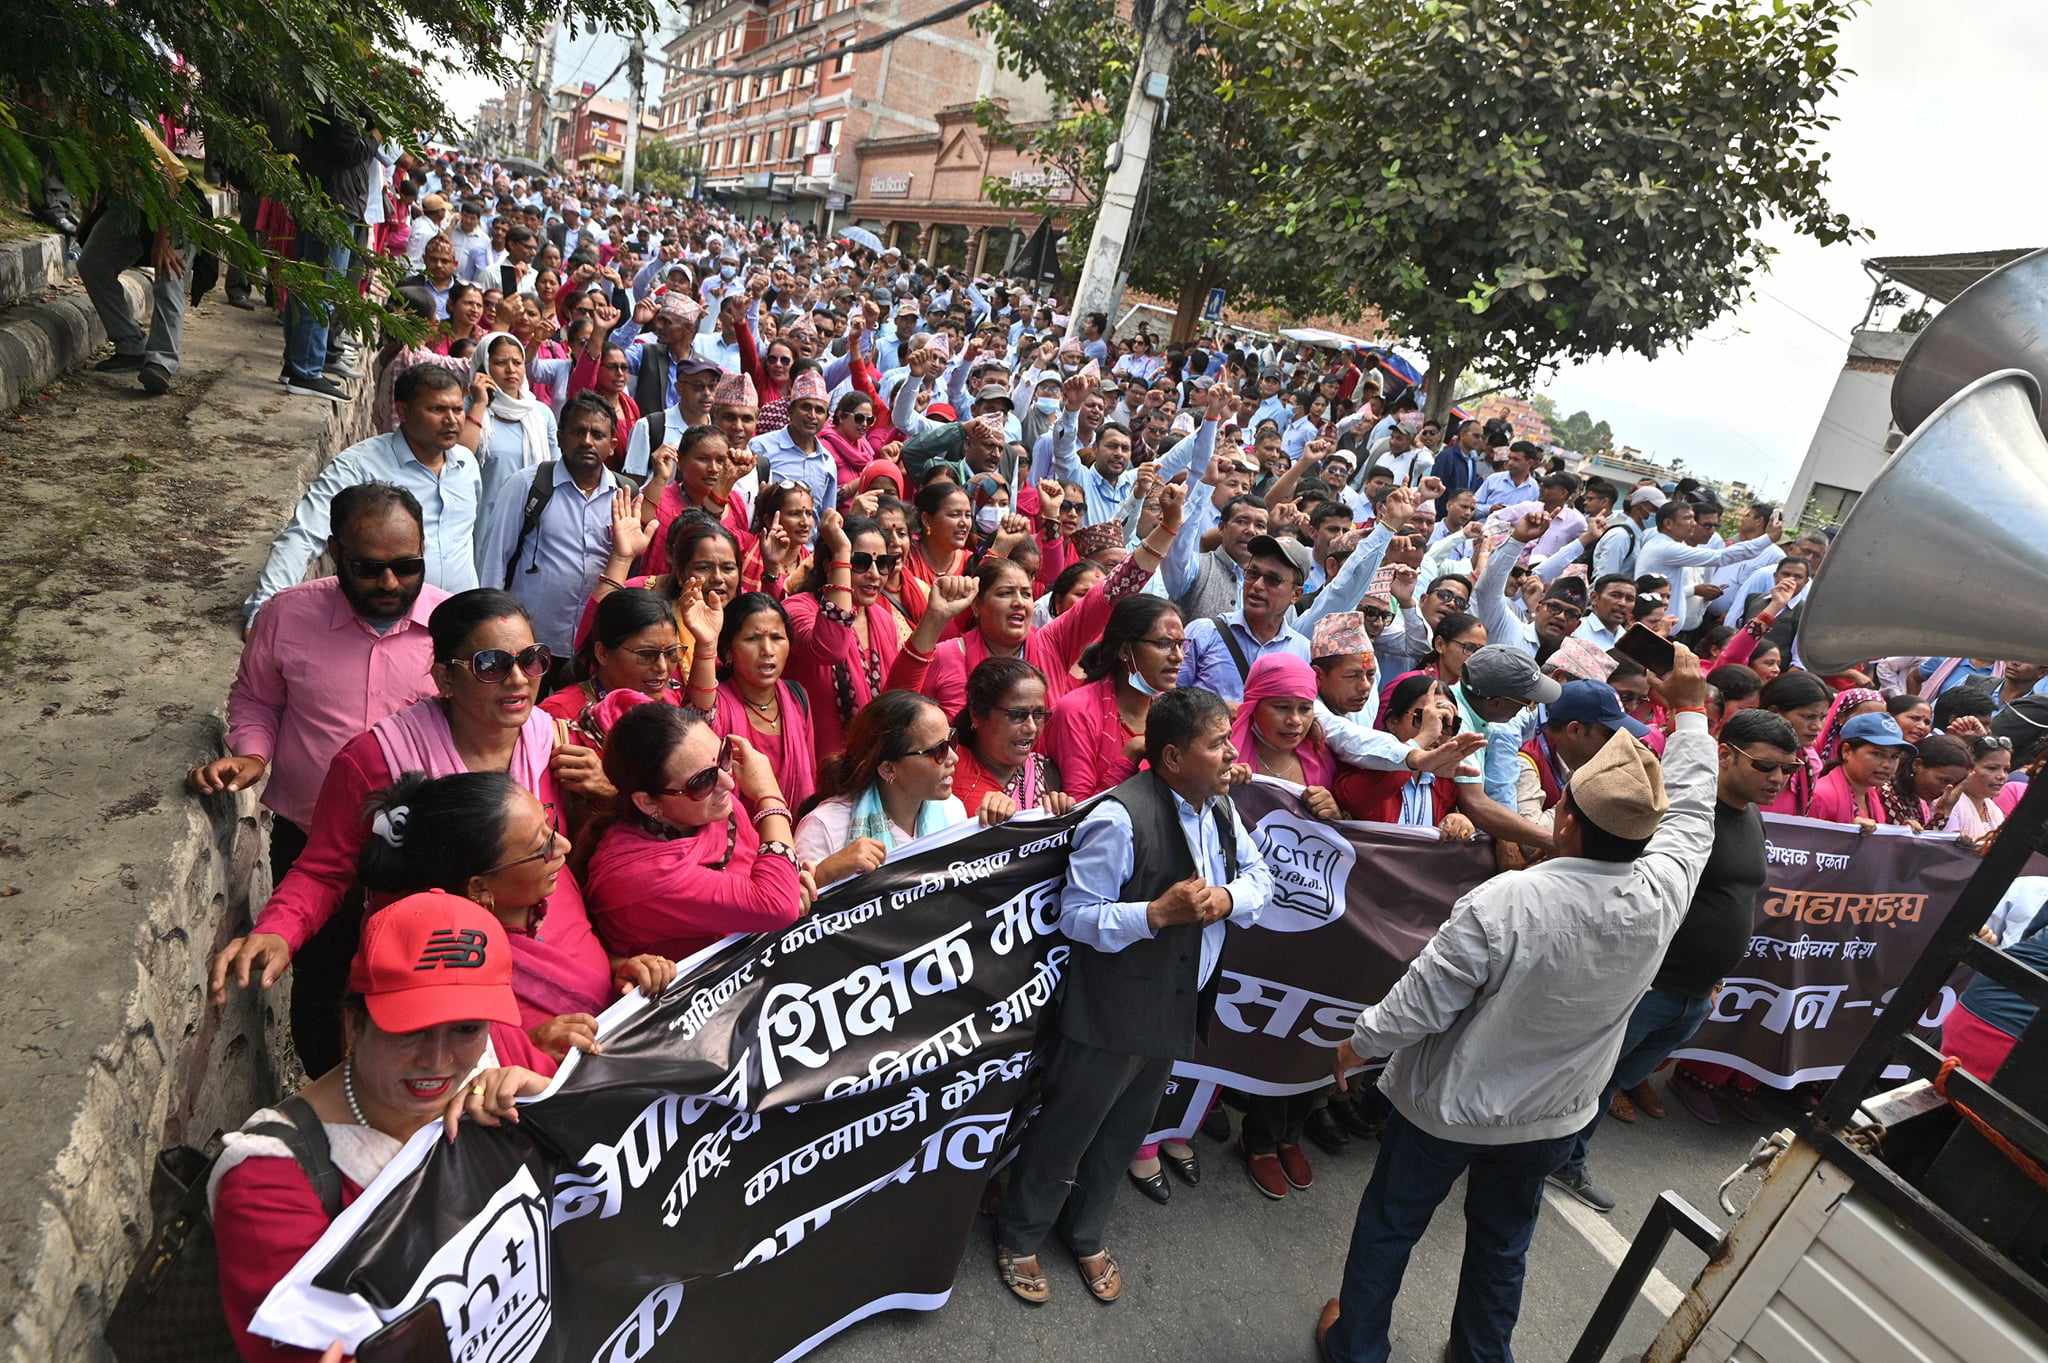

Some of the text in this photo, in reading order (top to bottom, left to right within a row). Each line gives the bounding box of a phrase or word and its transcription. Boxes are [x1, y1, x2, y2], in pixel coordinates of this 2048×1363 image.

[1272, 844, 1324, 873] cnt
[1816, 851, 1850, 873] एकता
[761, 942, 777, 967] र
[781, 895, 883, 955] कर्तव्यका
[890, 872, 946, 911] लागि
[948, 848, 1014, 888] शिक्षक
[1763, 887, 1929, 928] महासङ्घ
[1841, 937, 1877, 961] प्रदेश
[757, 921, 974, 1090] शिक्षक
[457, 1237, 527, 1336] nt
